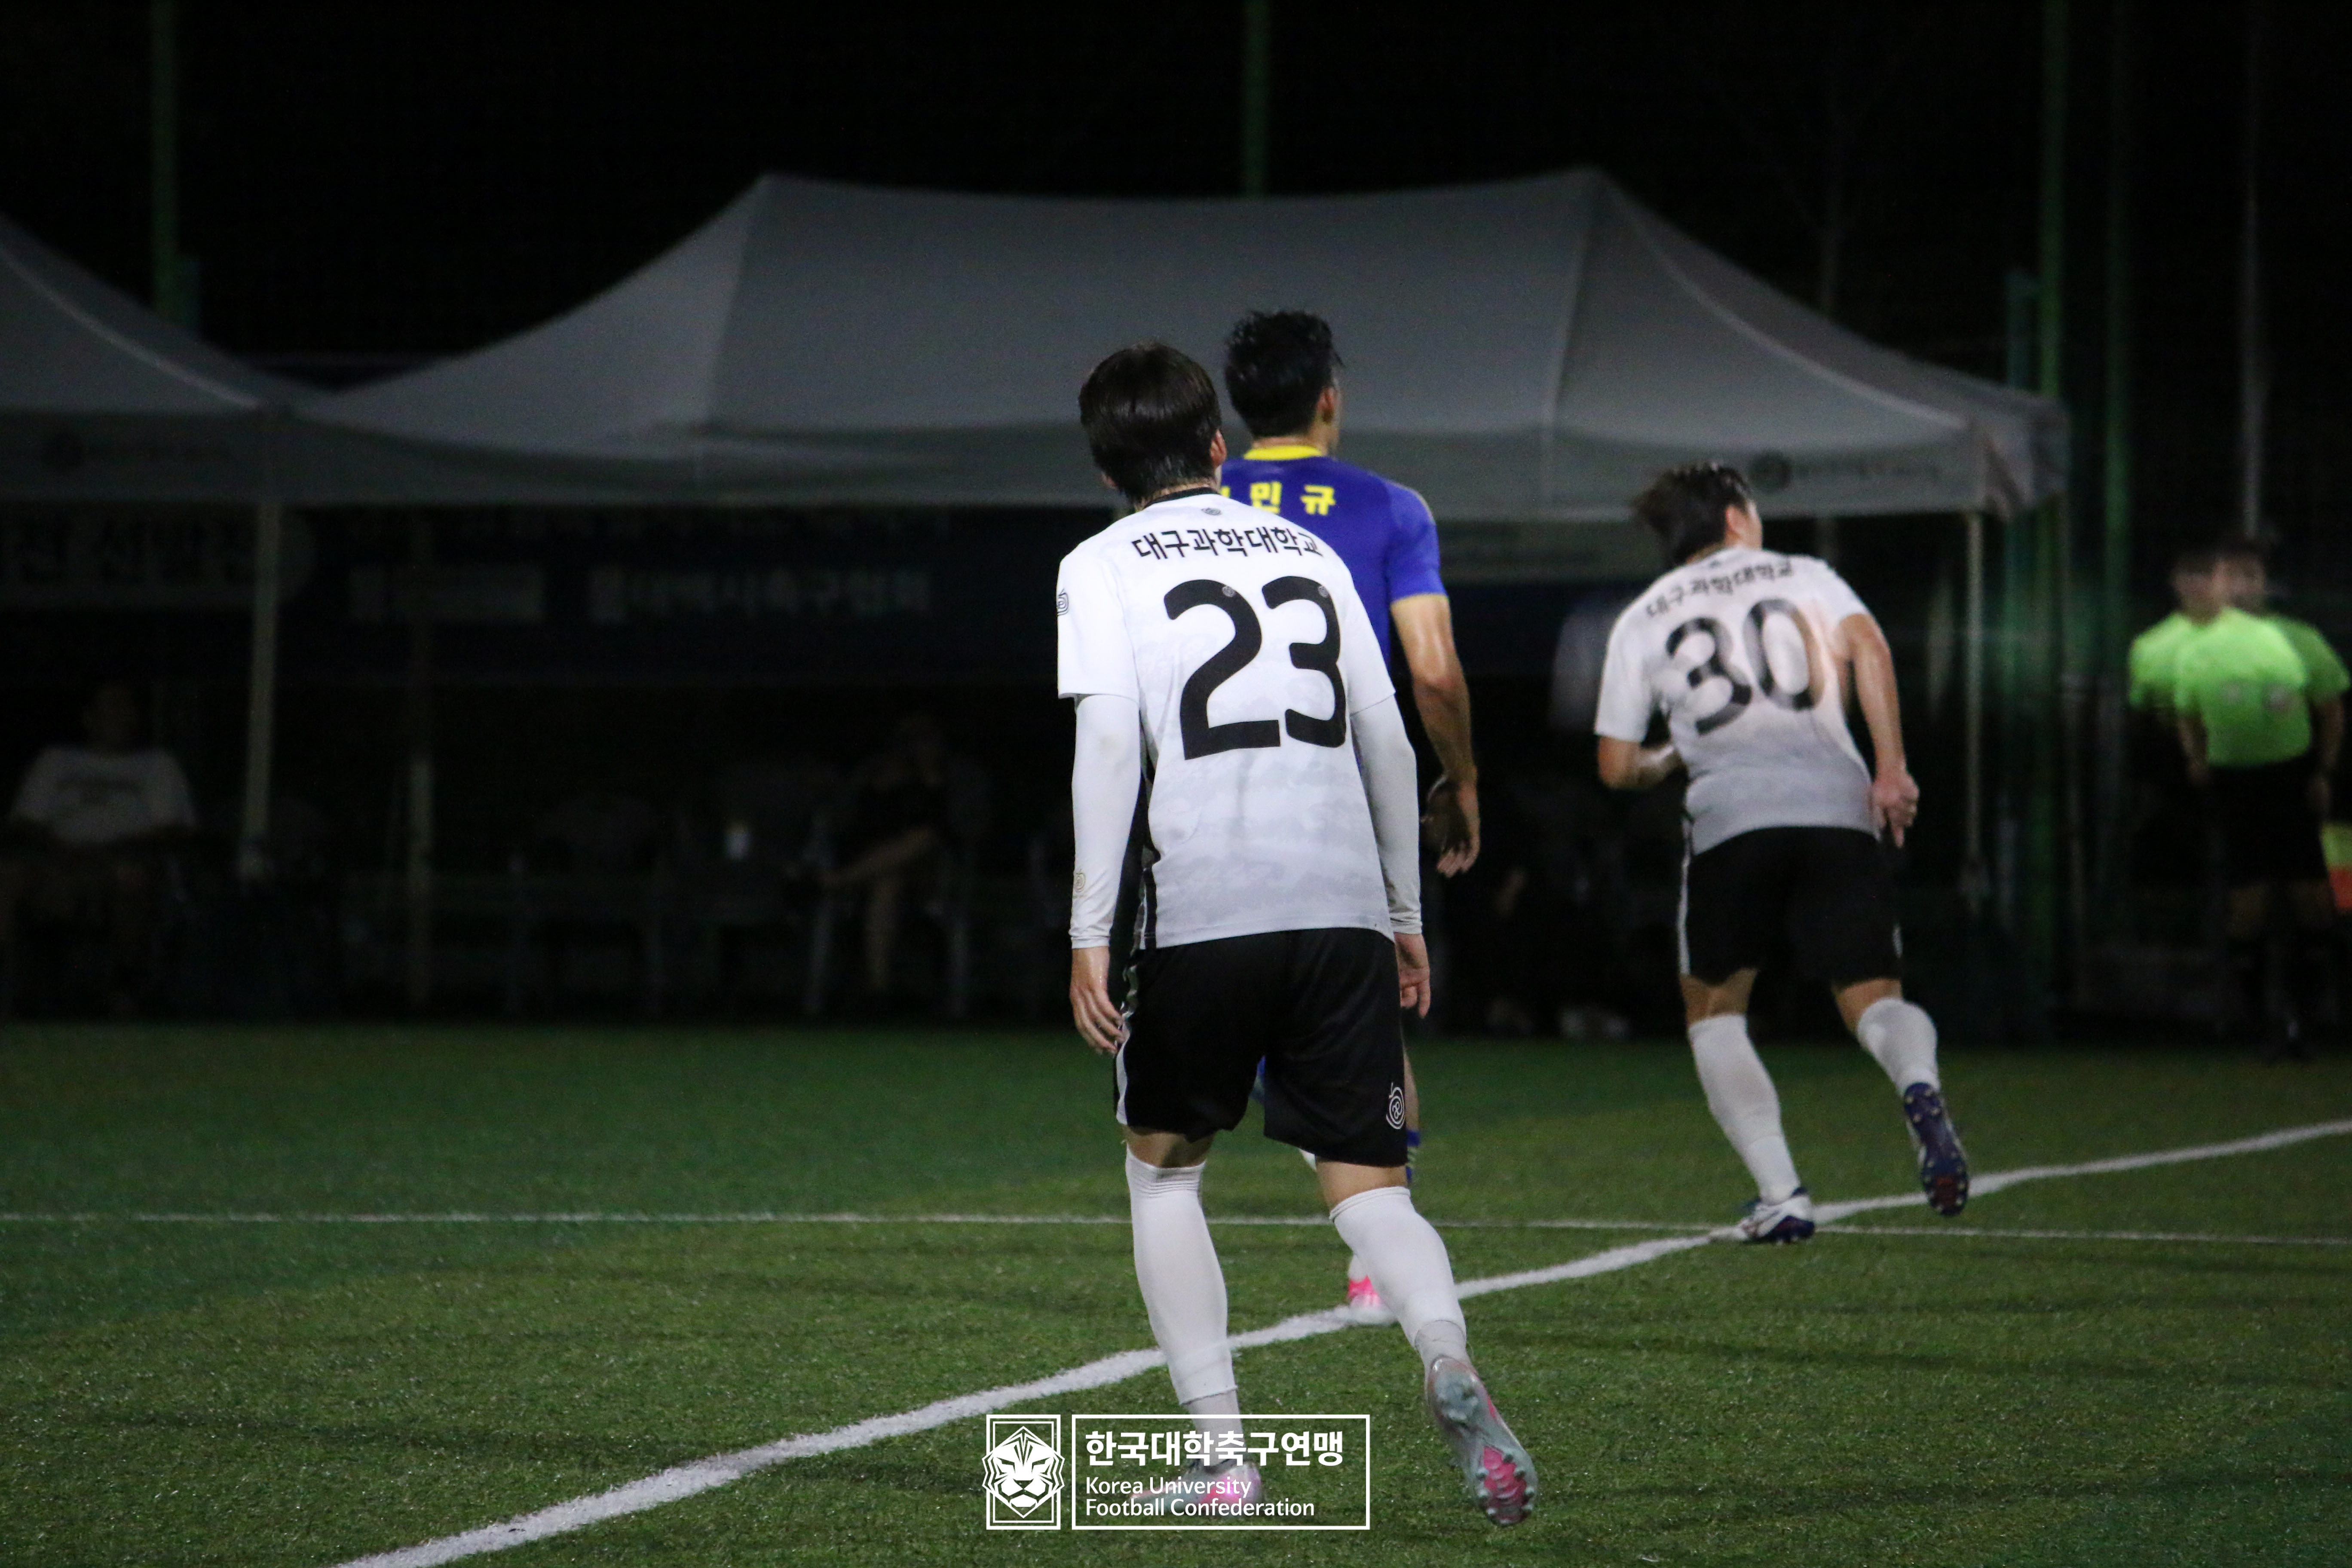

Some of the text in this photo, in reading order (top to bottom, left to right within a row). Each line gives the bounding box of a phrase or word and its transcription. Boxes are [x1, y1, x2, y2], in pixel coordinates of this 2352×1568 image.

[1220, 481, 1336, 515] 민규
[1132, 526, 1324, 560] 대구과학대학교
[1164, 576, 1347, 760] 23
[1665, 597, 1825, 736] 30
